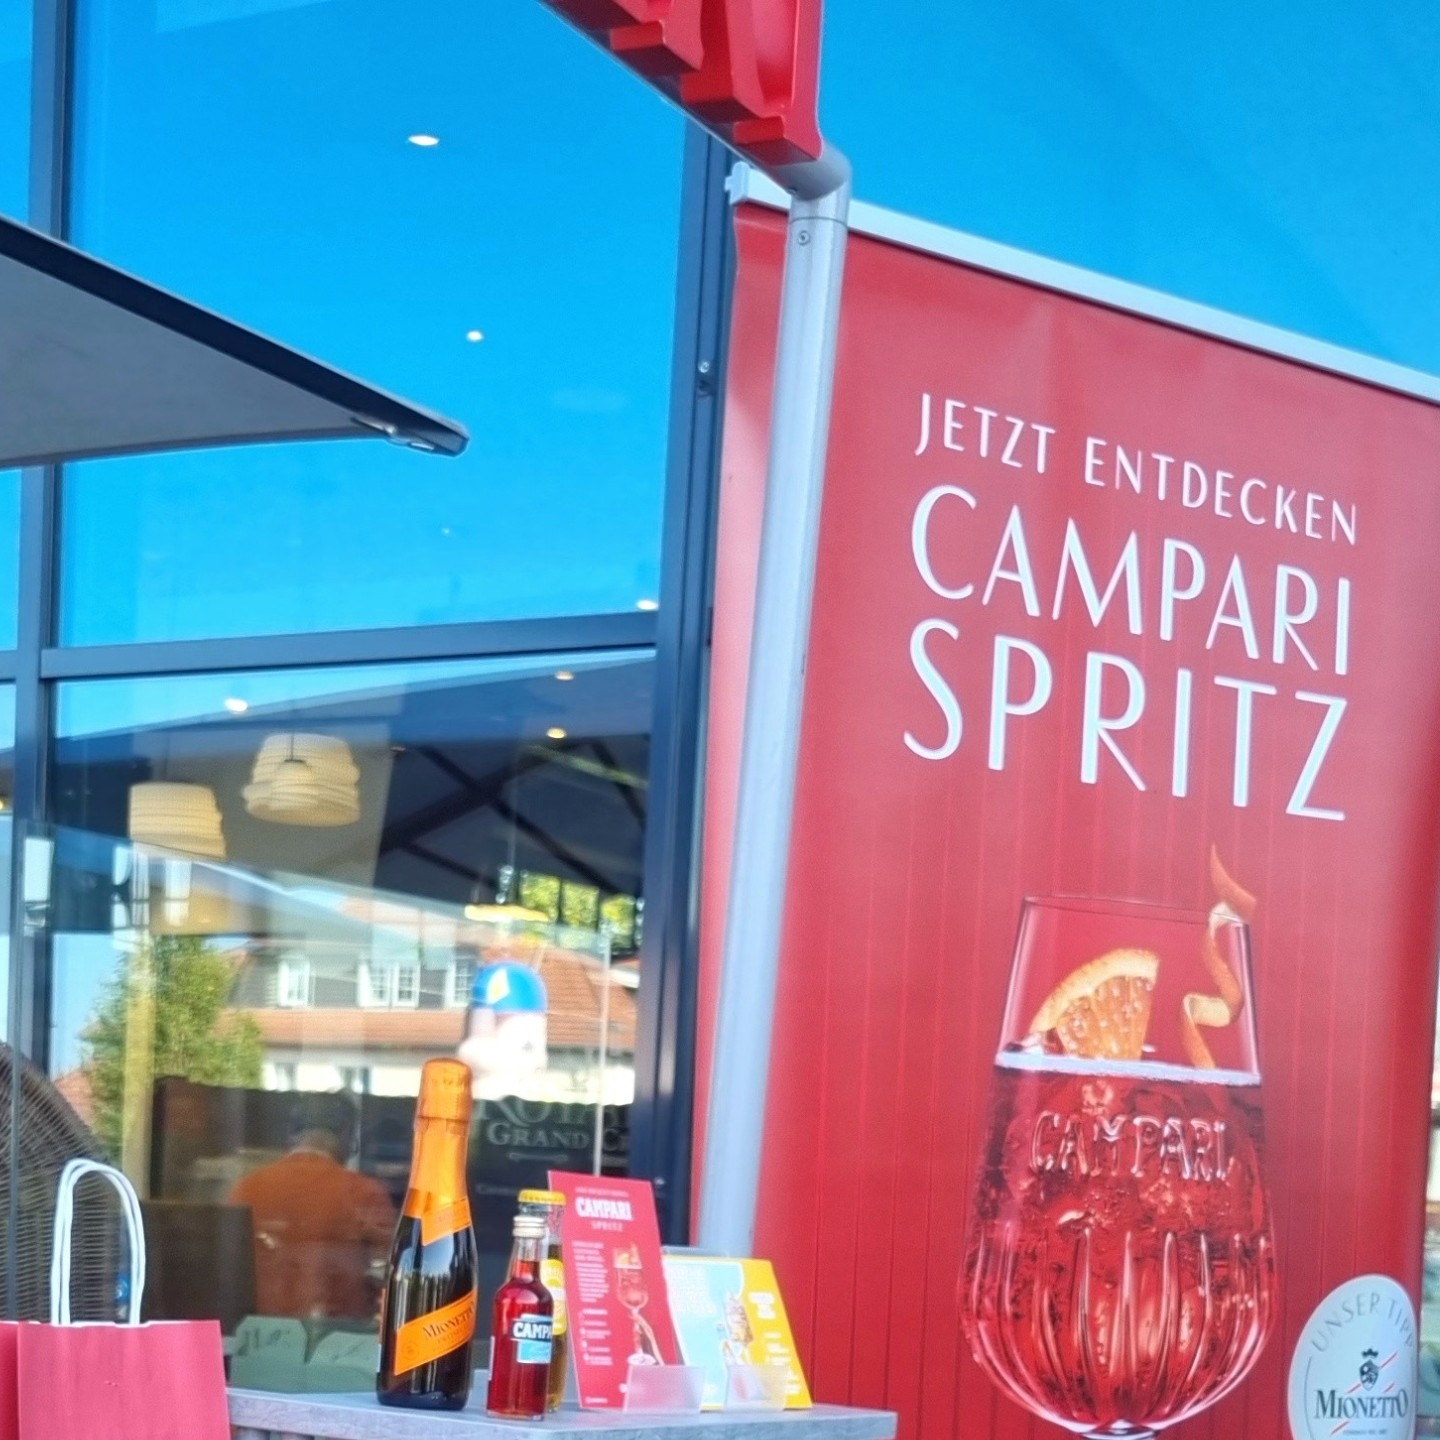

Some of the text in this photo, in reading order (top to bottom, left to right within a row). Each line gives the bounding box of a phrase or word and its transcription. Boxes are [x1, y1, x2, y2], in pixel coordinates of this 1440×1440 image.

[914, 393, 1357, 546] JETZT ENTDECKEN
[911, 484, 1351, 675] CAMPARI
[903, 618, 1348, 822] SPRITZ
[1311, 1292, 1380, 1352] UNSER
